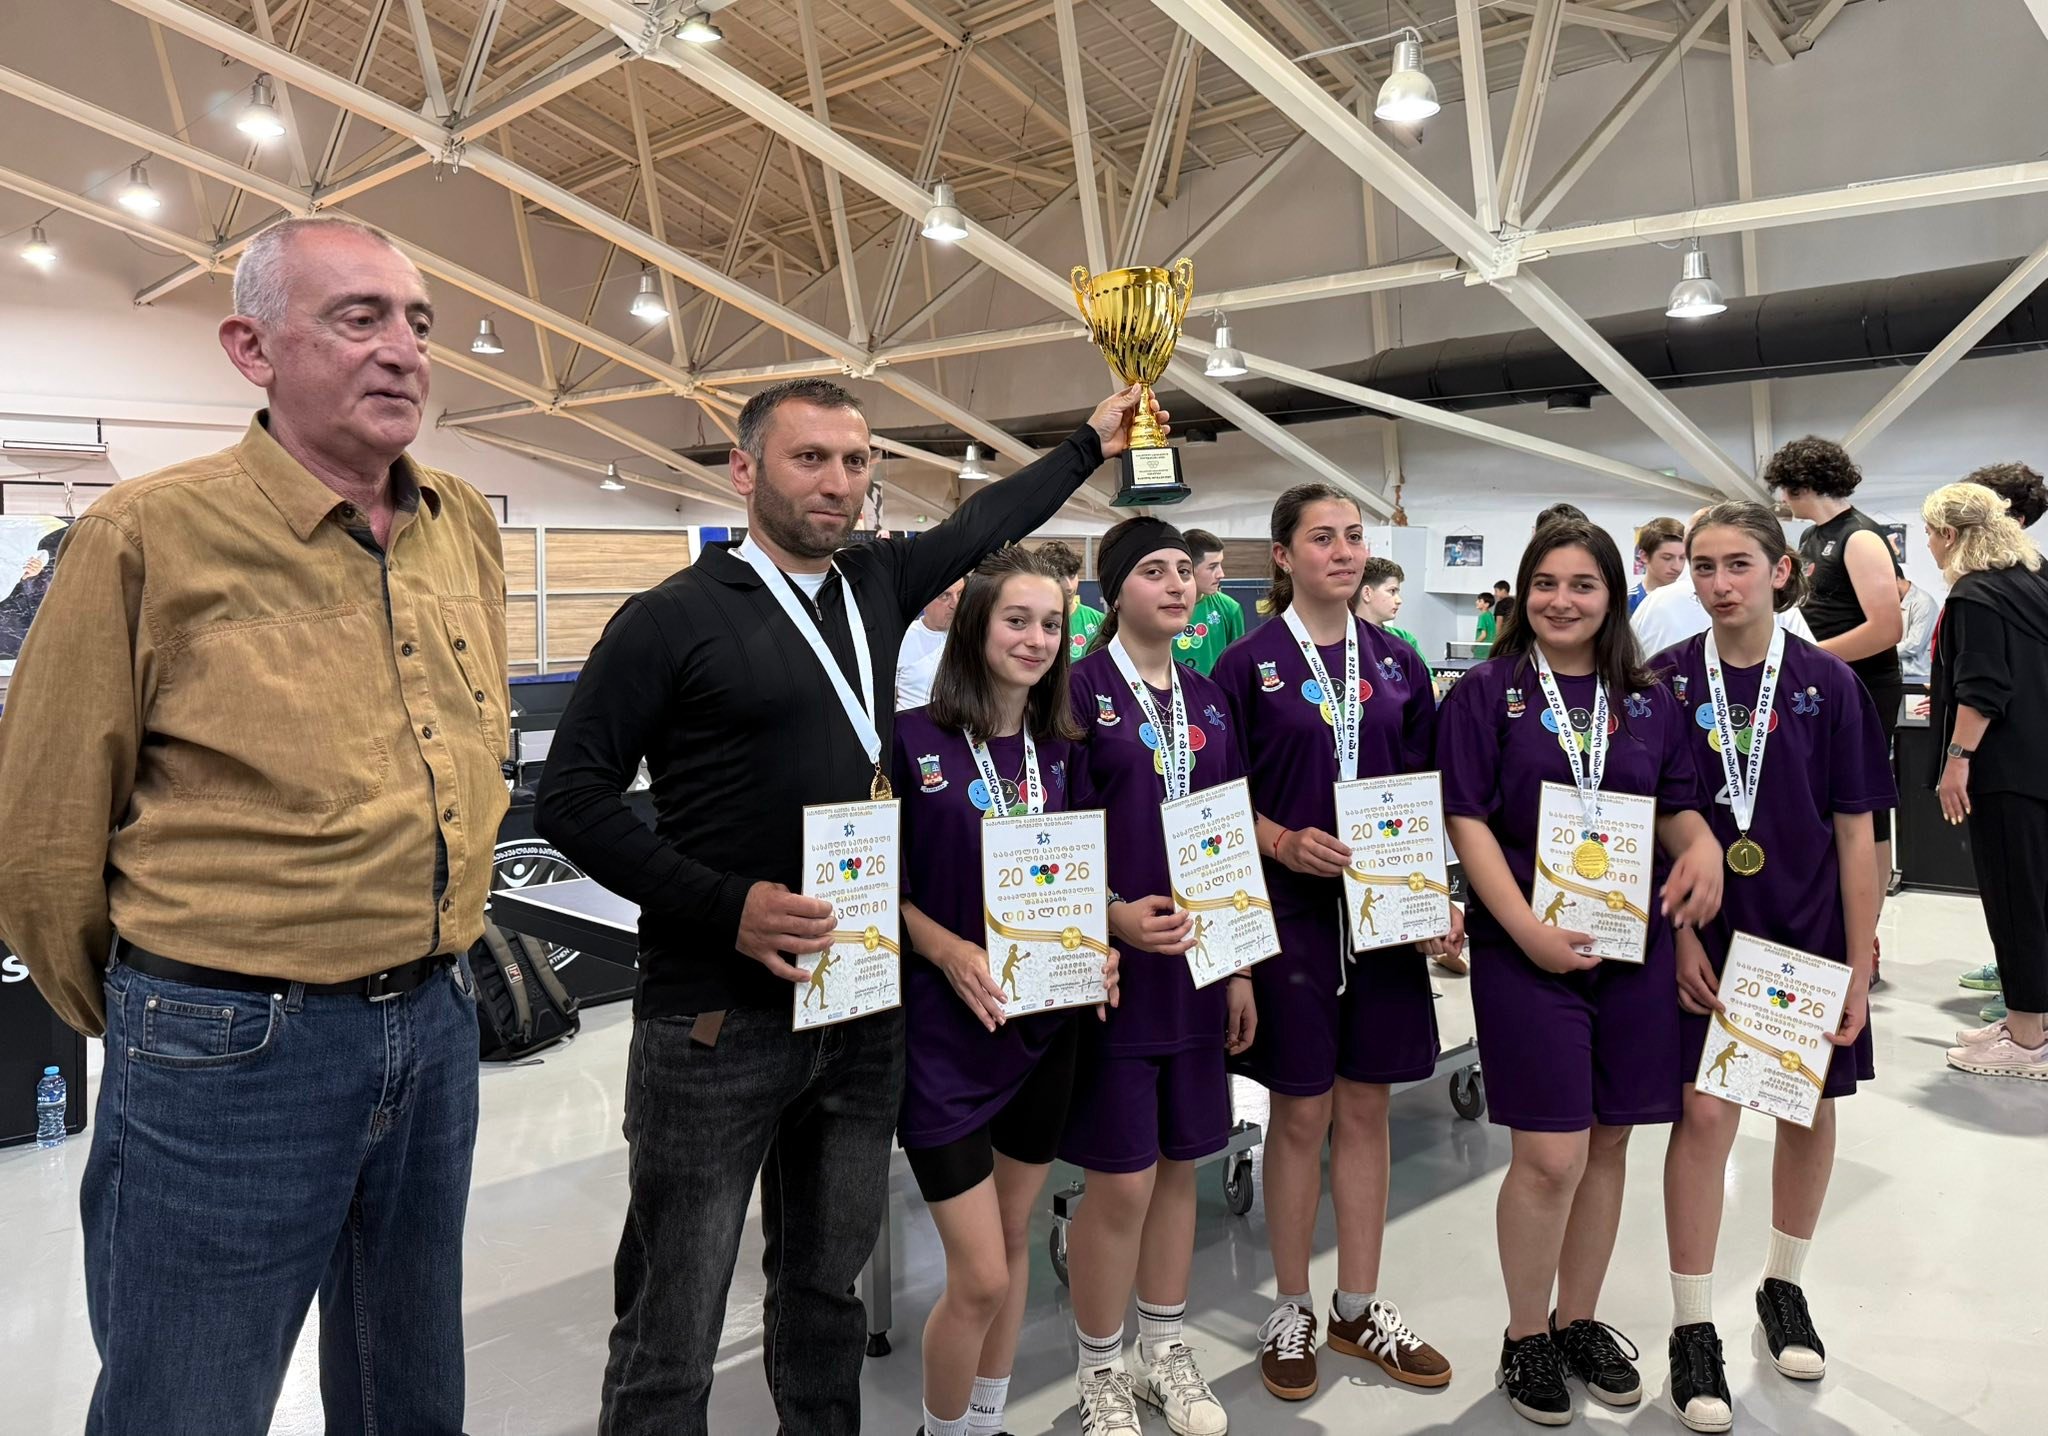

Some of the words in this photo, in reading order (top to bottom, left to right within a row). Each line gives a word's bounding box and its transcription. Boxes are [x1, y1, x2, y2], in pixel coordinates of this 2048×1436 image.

[1348, 656, 1356, 681] 2026
[1176, 700, 1185, 726] 2026
[1547, 689, 1564, 716] 2026
[1714, 687, 1730, 745] სპორტული
[1348, 688, 1357, 760] ოლიმპიადა
[1561, 722, 1582, 787] ლიმპიადა
[1747, 721, 1765, 797] ოლიმპიადა
[1758, 686, 1771, 715] 2026
[1177, 733, 1188, 798] ლიმპიადა
[1725, 747, 1740, 797] სასკოლო
[1028, 767, 1039, 798] 2026
[1351, 822, 1372, 841] 20
[1407, 816, 1429, 834] 26
[1551, 826, 1575, 844] 20
[1613, 835, 1637, 854] 26
[815, 861, 834, 884] 20
[865, 854, 886, 876] 26
[998, 867, 1023, 888] 20
[1064, 861, 1090, 881] 26
[1552, 862, 1638, 884] დიომი
[837, 899, 887, 919] პლომი
[1001, 903, 1093, 922] დიპლომი
[1734, 977, 1760, 998] 20
[1798, 998, 1826, 1019] 26
